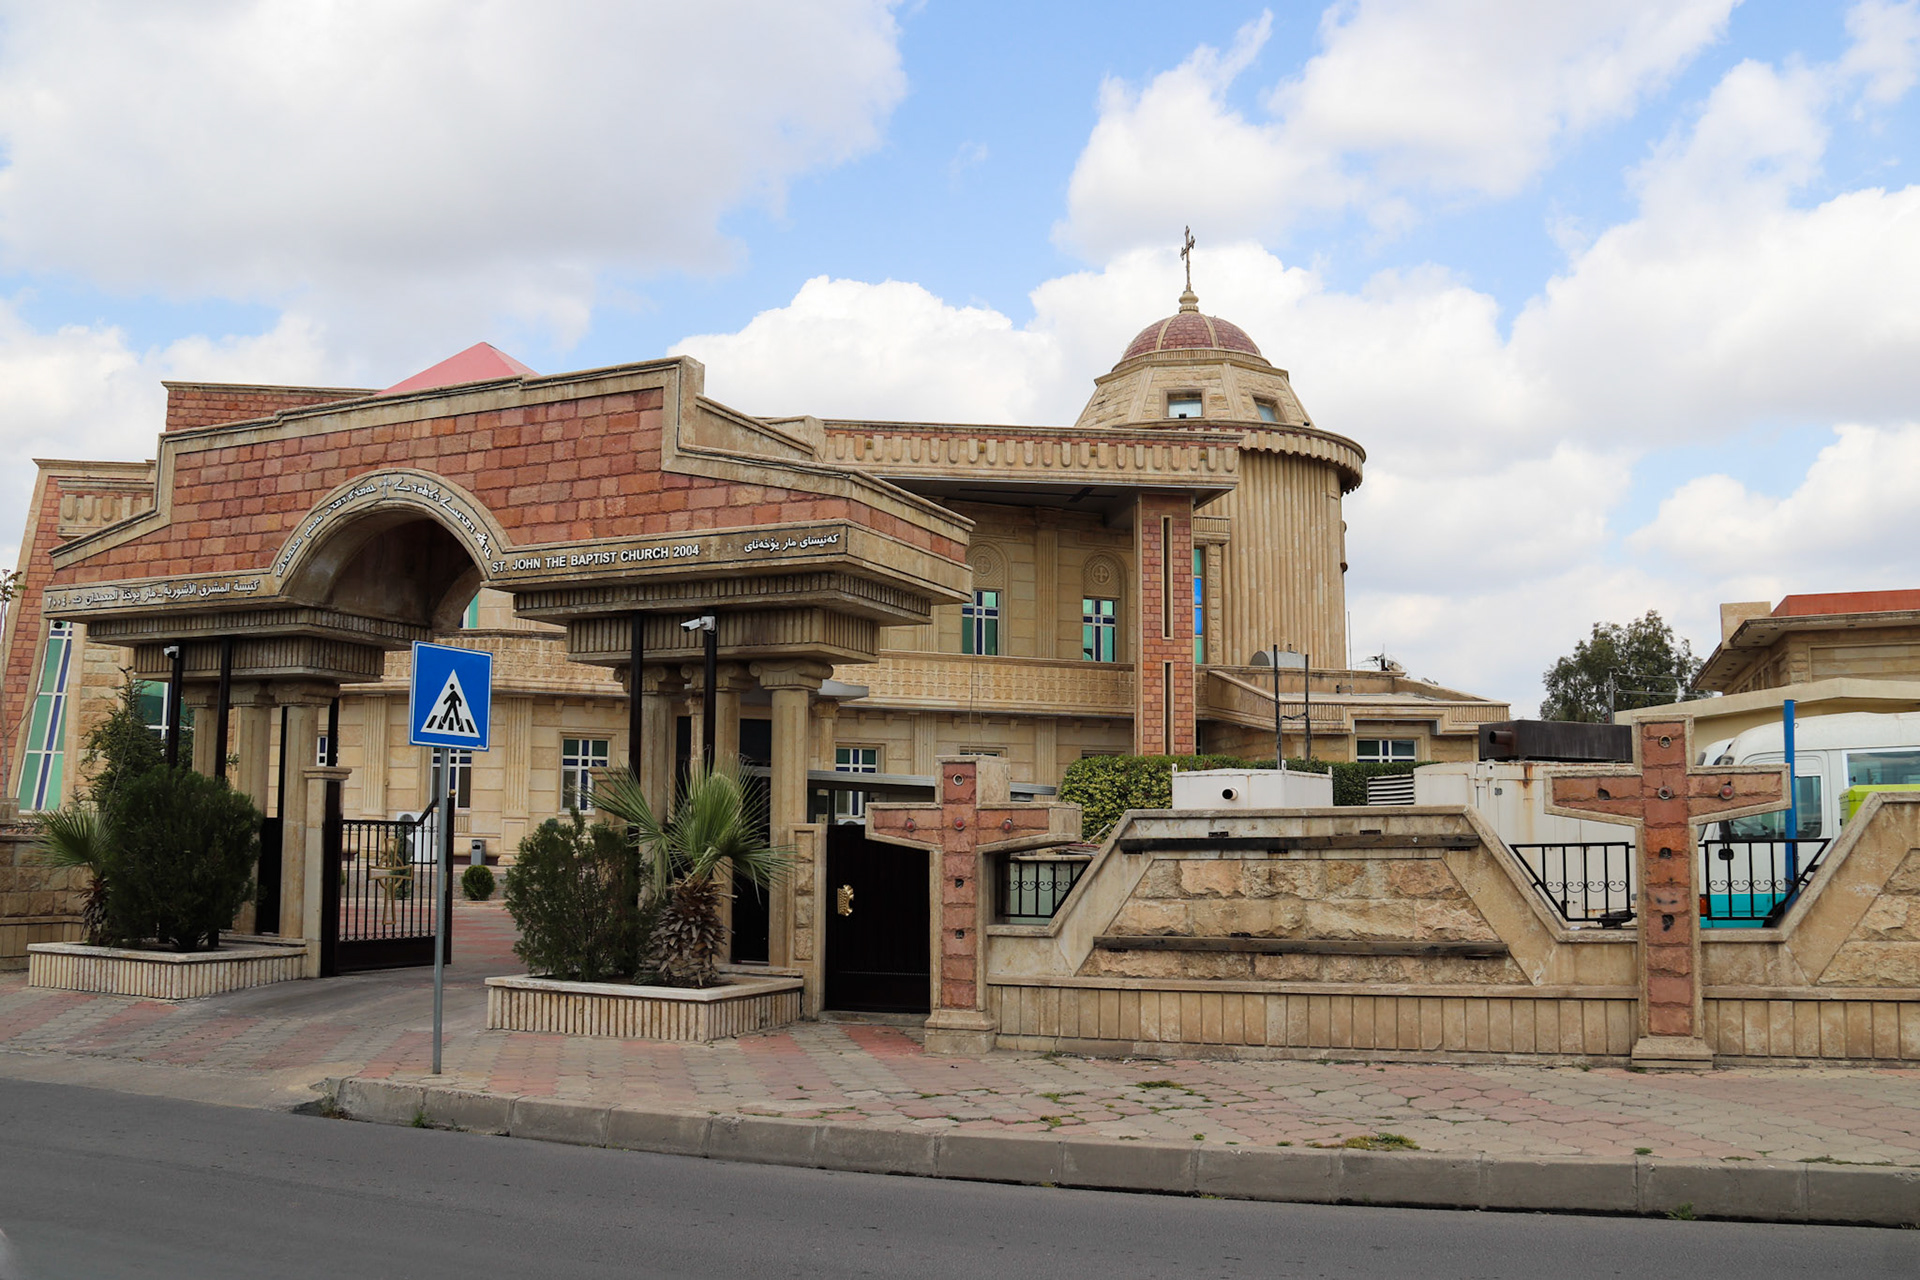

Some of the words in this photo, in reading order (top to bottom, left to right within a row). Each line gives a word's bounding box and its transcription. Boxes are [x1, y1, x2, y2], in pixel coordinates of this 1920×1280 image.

[782, 537, 797, 551] مار
[492, 561, 509, 572] ST.
[512, 558, 541, 570] JOHN
[545, 556, 567, 568] THE
[570, 551, 618, 566] BAPTIST
[620, 547, 669, 562] CHURCH
[673, 545, 700, 559] 2004
[143, 588, 157, 602] مار
[199, 581, 231, 597] المشرق
[233, 580, 260, 595] كنيسة
[85, 589, 119, 606] المعمدان
